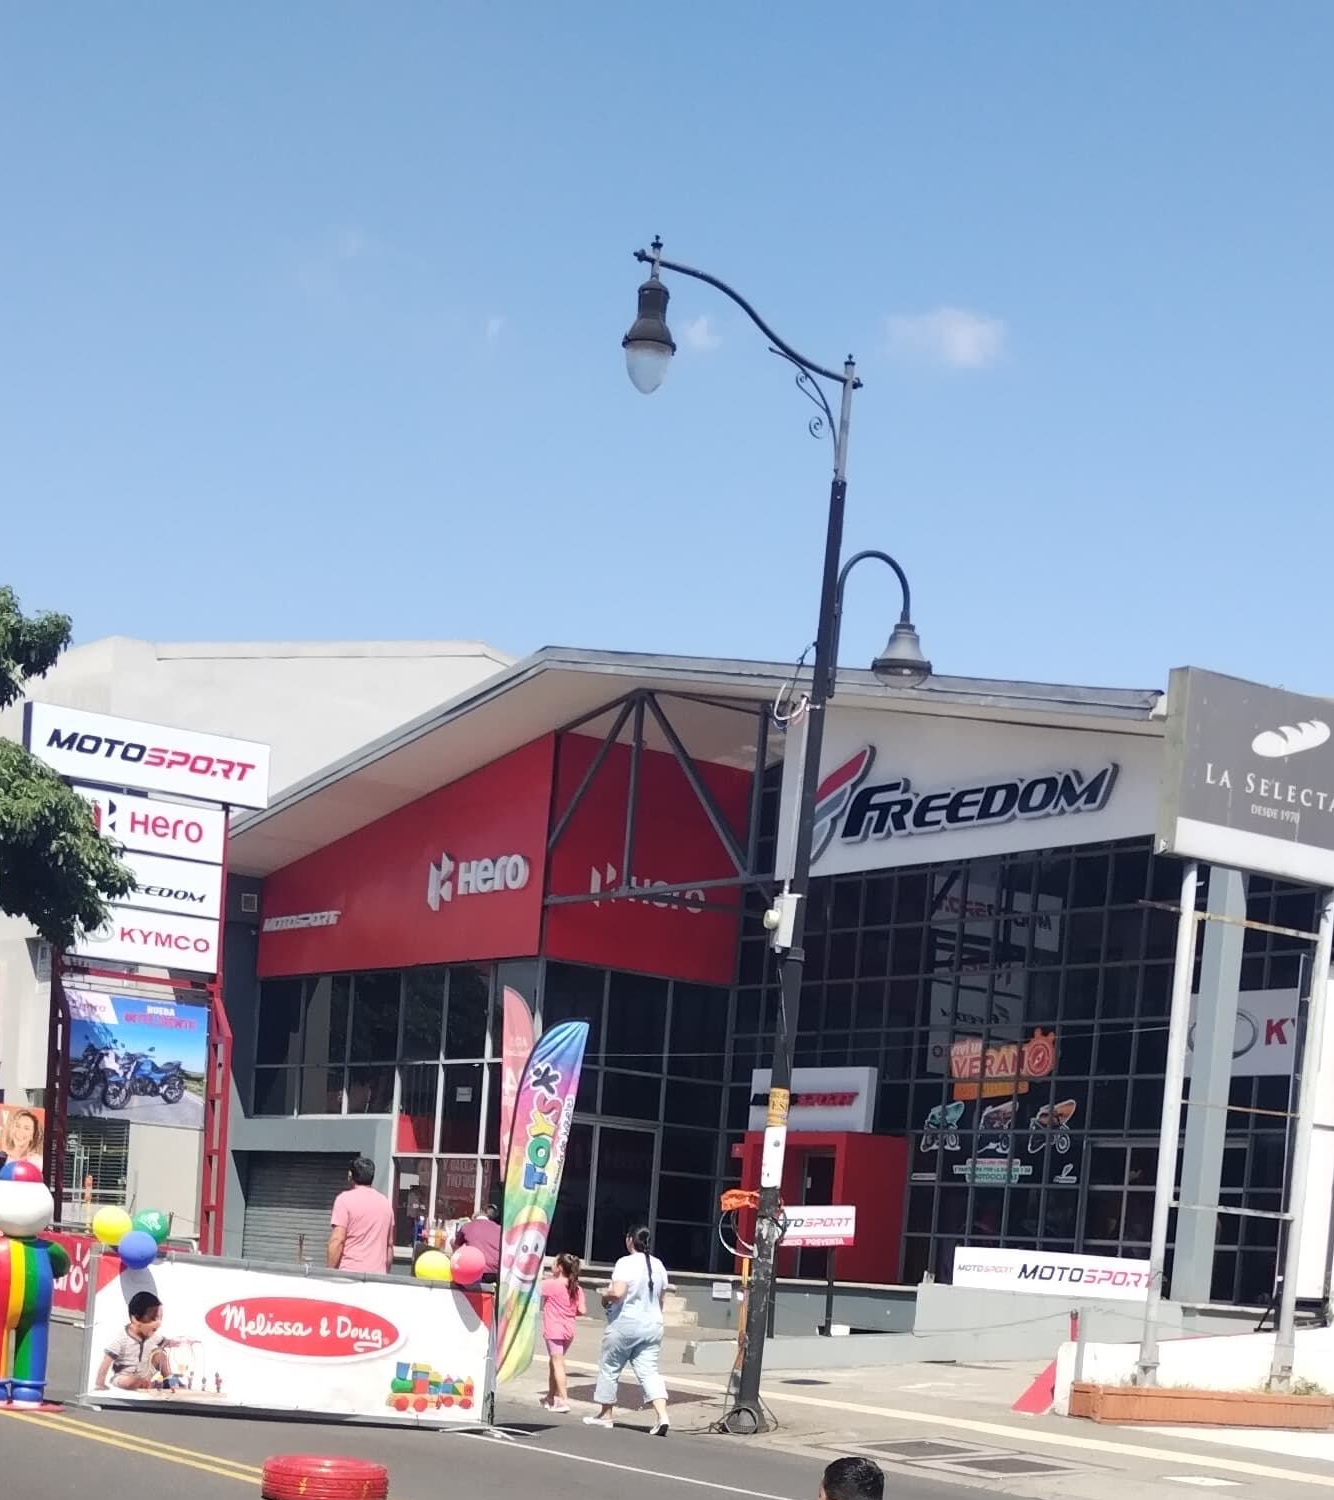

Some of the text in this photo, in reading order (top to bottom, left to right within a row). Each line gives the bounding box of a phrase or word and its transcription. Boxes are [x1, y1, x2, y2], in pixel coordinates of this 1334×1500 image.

[47, 728, 256, 781] MOTOSPORT
[1205, 763, 1232, 788] LA
[841, 763, 1113, 839] FREEDOM
[1251, 804, 1300, 824] DESDE 1970
[130, 811, 204, 843] Hero
[458, 854, 529, 895] Hero
[131, 883, 207, 903] EEDOM
[263, 910, 341, 932] MOTOSPORT
[120, 926, 210, 953] KYMCO
[2, 1110, 10, 1126] Y
[957, 1263, 1152, 1288] MOTOSPORT MOTOSPORT
[221, 1304, 383, 1352] Melissa & Doug
